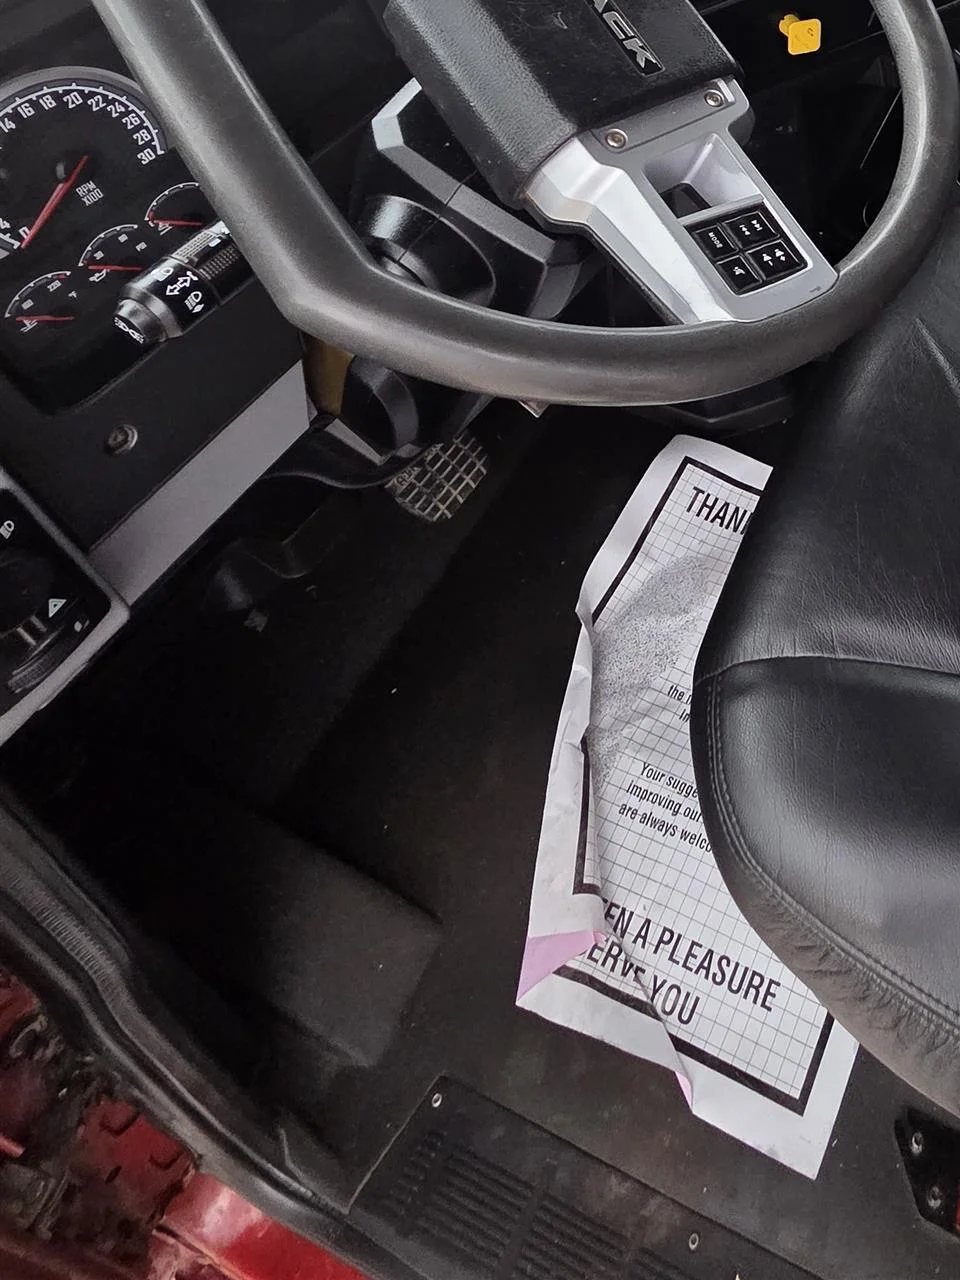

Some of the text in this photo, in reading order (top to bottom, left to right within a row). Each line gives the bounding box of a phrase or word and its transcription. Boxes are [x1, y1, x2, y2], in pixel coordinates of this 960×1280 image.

[38, 94, 57, 111] 18
[62, 91, 83, 109] 20
[87, 95, 107, 112] 22
[17, 102, 35, 119] 16
[107, 101, 126, 118] 24
[0, 117, 16, 133] 14
[122, 112, 141, 130] 26
[132, 128, 151, 146] 28
[136, 147, 156, 166] 30
[75, 180, 97, 198] RPM
[81, 189, 104, 207] X100
[708, 231, 723, 249] MODE
[686, 486, 754, 535] THAN
[667, 684, 685, 702] the
[640, 761, 666, 783] Your
[625, 780, 702, 823] improving our
[618, 802, 712, 853] are always welco
[602, 899, 781, 1012] EN A PLEASURE
[586, 938, 701, 1026] ERVE YOU
